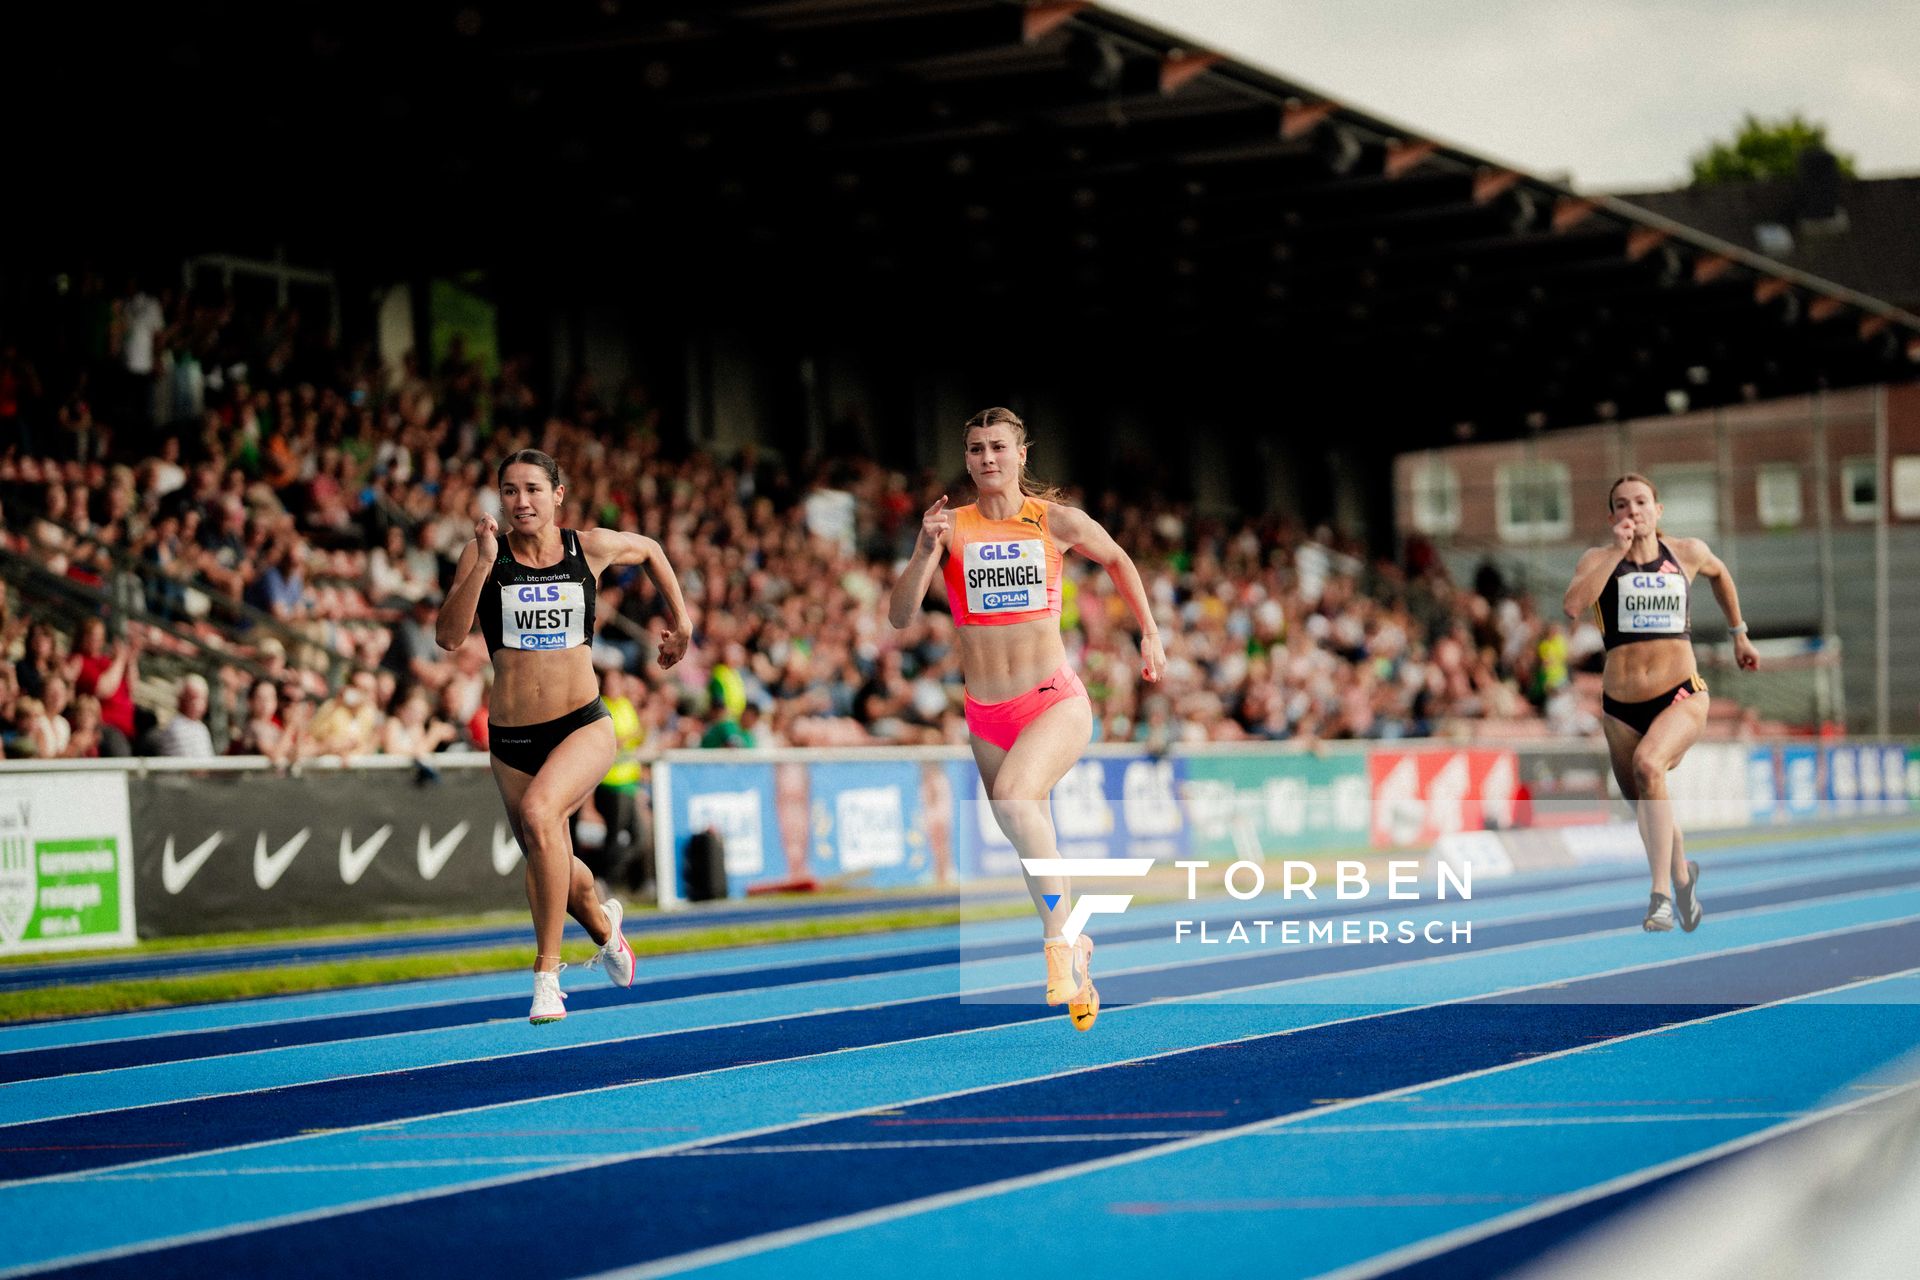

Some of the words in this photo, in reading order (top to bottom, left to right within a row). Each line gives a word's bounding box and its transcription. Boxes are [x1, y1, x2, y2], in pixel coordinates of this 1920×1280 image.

[540, 573, 570, 581] markets
[968, 565, 1042, 588] SPRENGEL
[1002, 593, 1027, 602] PLAN
[1626, 595, 1680, 611] GRIMM
[514, 608, 573, 629] WEST
[540, 635, 565, 644] PLAN
